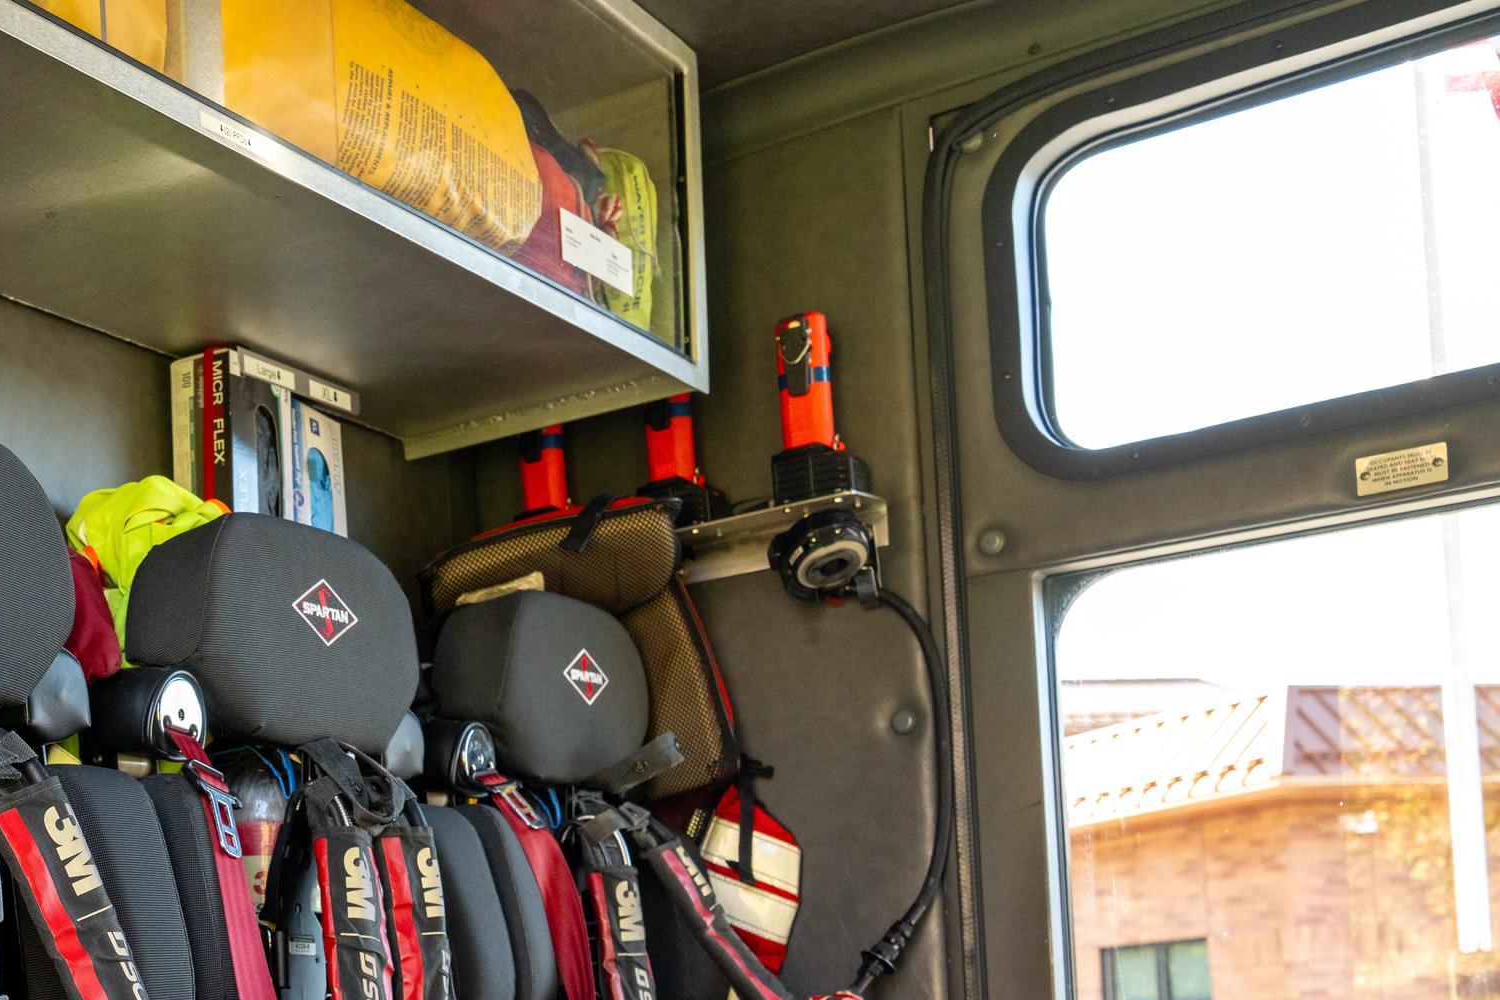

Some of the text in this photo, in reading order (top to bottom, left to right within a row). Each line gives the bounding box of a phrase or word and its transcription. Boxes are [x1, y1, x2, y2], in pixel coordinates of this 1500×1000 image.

[256, 363, 277, 381] Large
[302, 600, 350, 625] SPARTAN
[570, 667, 604, 687] SPARTAN
[42, 804, 104, 897] 3M
[343, 846, 376, 920] 3M
[614, 879, 646, 943] 3M
